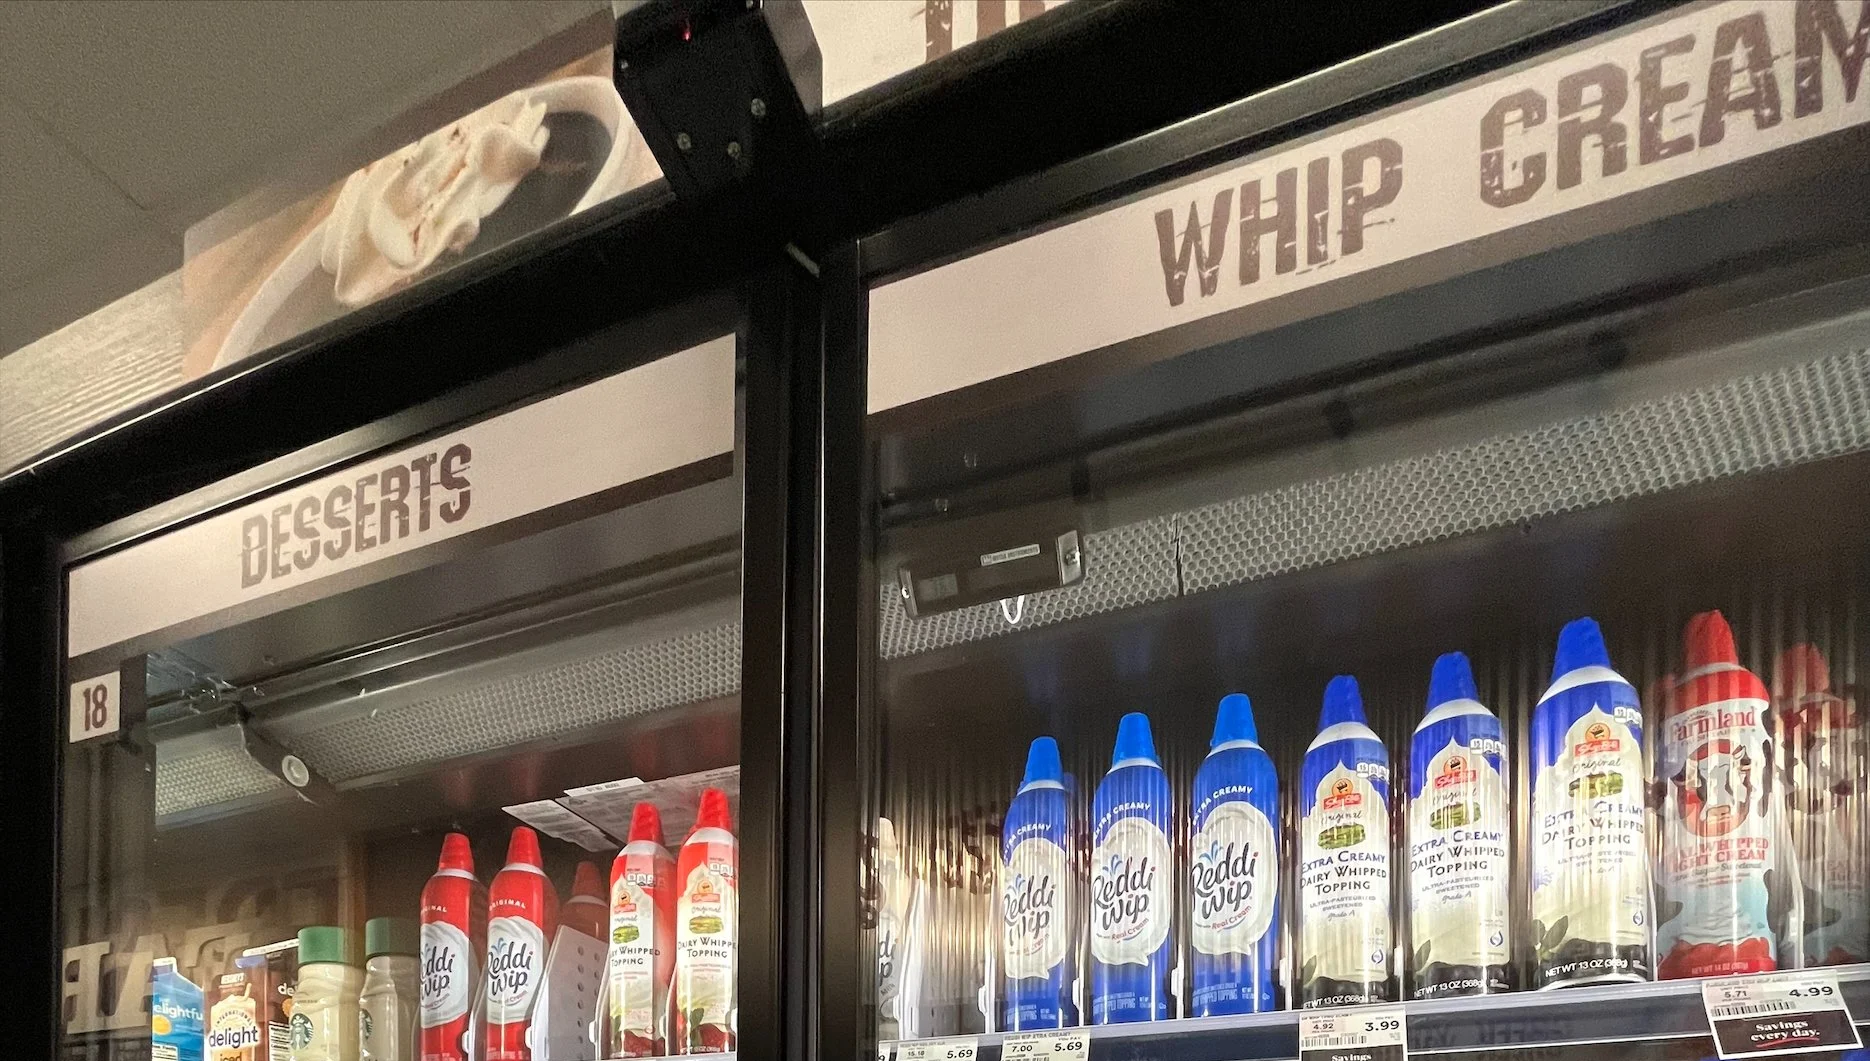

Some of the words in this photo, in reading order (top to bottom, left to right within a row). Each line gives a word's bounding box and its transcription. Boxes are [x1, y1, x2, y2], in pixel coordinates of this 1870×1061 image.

[1154, 137, 1402, 307] WHIP
[1479, 0, 1870, 208] CREAM
[241, 443, 472, 589] DESSERTS
[82, 684, 108, 731] 18
[1212, 785, 1254, 800] CREAMY
[1114, 802, 1151, 815] CREAMY
[1411, 836, 1447, 858] EXTRA
[1453, 829, 1503, 845] CREAMY
[1301, 851, 1333, 875] EXTRA
[1338, 849, 1386, 864] CREAMY
[1410, 852, 1443, 873] DAIRY
[1448, 844, 1505, 862] WHIPPED
[1427, 859, 1488, 878] TOPPING
[1192, 840, 1258, 902] Reddi
[1300, 868, 1332, 888] DAIRY
[1334, 864, 1388, 880] WHIPPED
[1093, 856, 1156, 913] Reddi
[1315, 879, 1371, 895] TOPPING
[487, 941, 534, 980] Reddi
[688, 949, 728, 960] TOPPING
[1788, 985, 1834, 999] 4.99
[1313, 1022, 1334, 1031] 4.92
[1364, 1019, 1400, 1033] 3.99
[1751, 1029, 1788, 1042] every
[1792, 1028, 1821, 1039] day.
[1756, 1019, 1809, 1032] Savings
[208, 1026, 259, 1049] delight
[1011, 1045, 1033, 1054] 7.00
[1053, 1041, 1083, 1053] 5.69
[946, 1048, 973, 1059] 5.69
